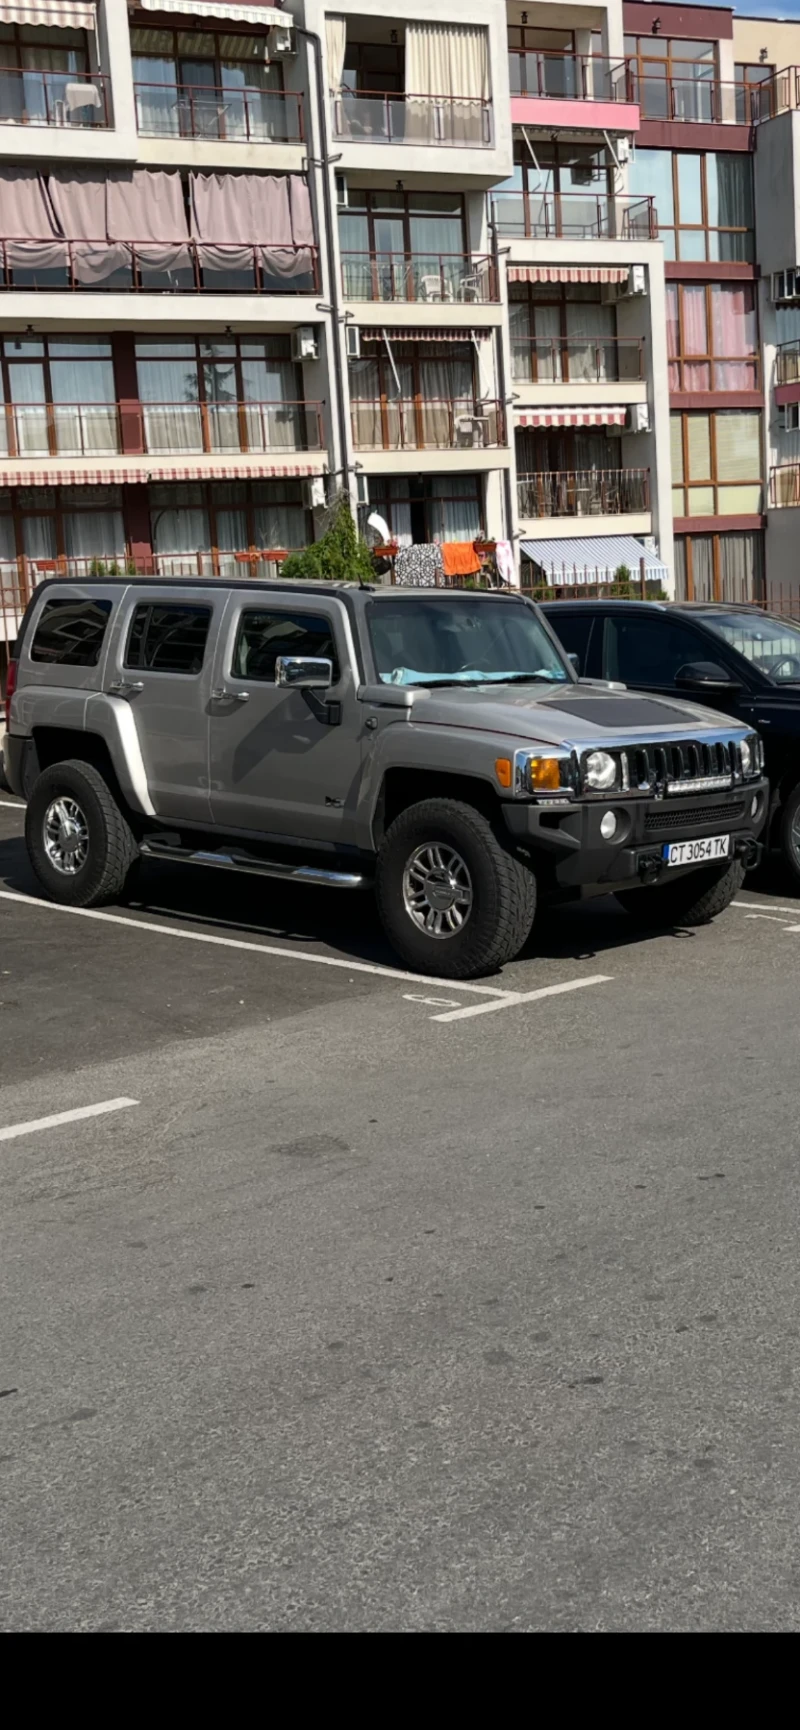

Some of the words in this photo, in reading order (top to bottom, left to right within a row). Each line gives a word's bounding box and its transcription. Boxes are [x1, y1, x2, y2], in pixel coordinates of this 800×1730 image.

[670, 844, 686, 863] CT
[687, 841, 711, 860] 3054
[714, 837, 727, 856] TK
[402, 994, 461, 1007] 6
